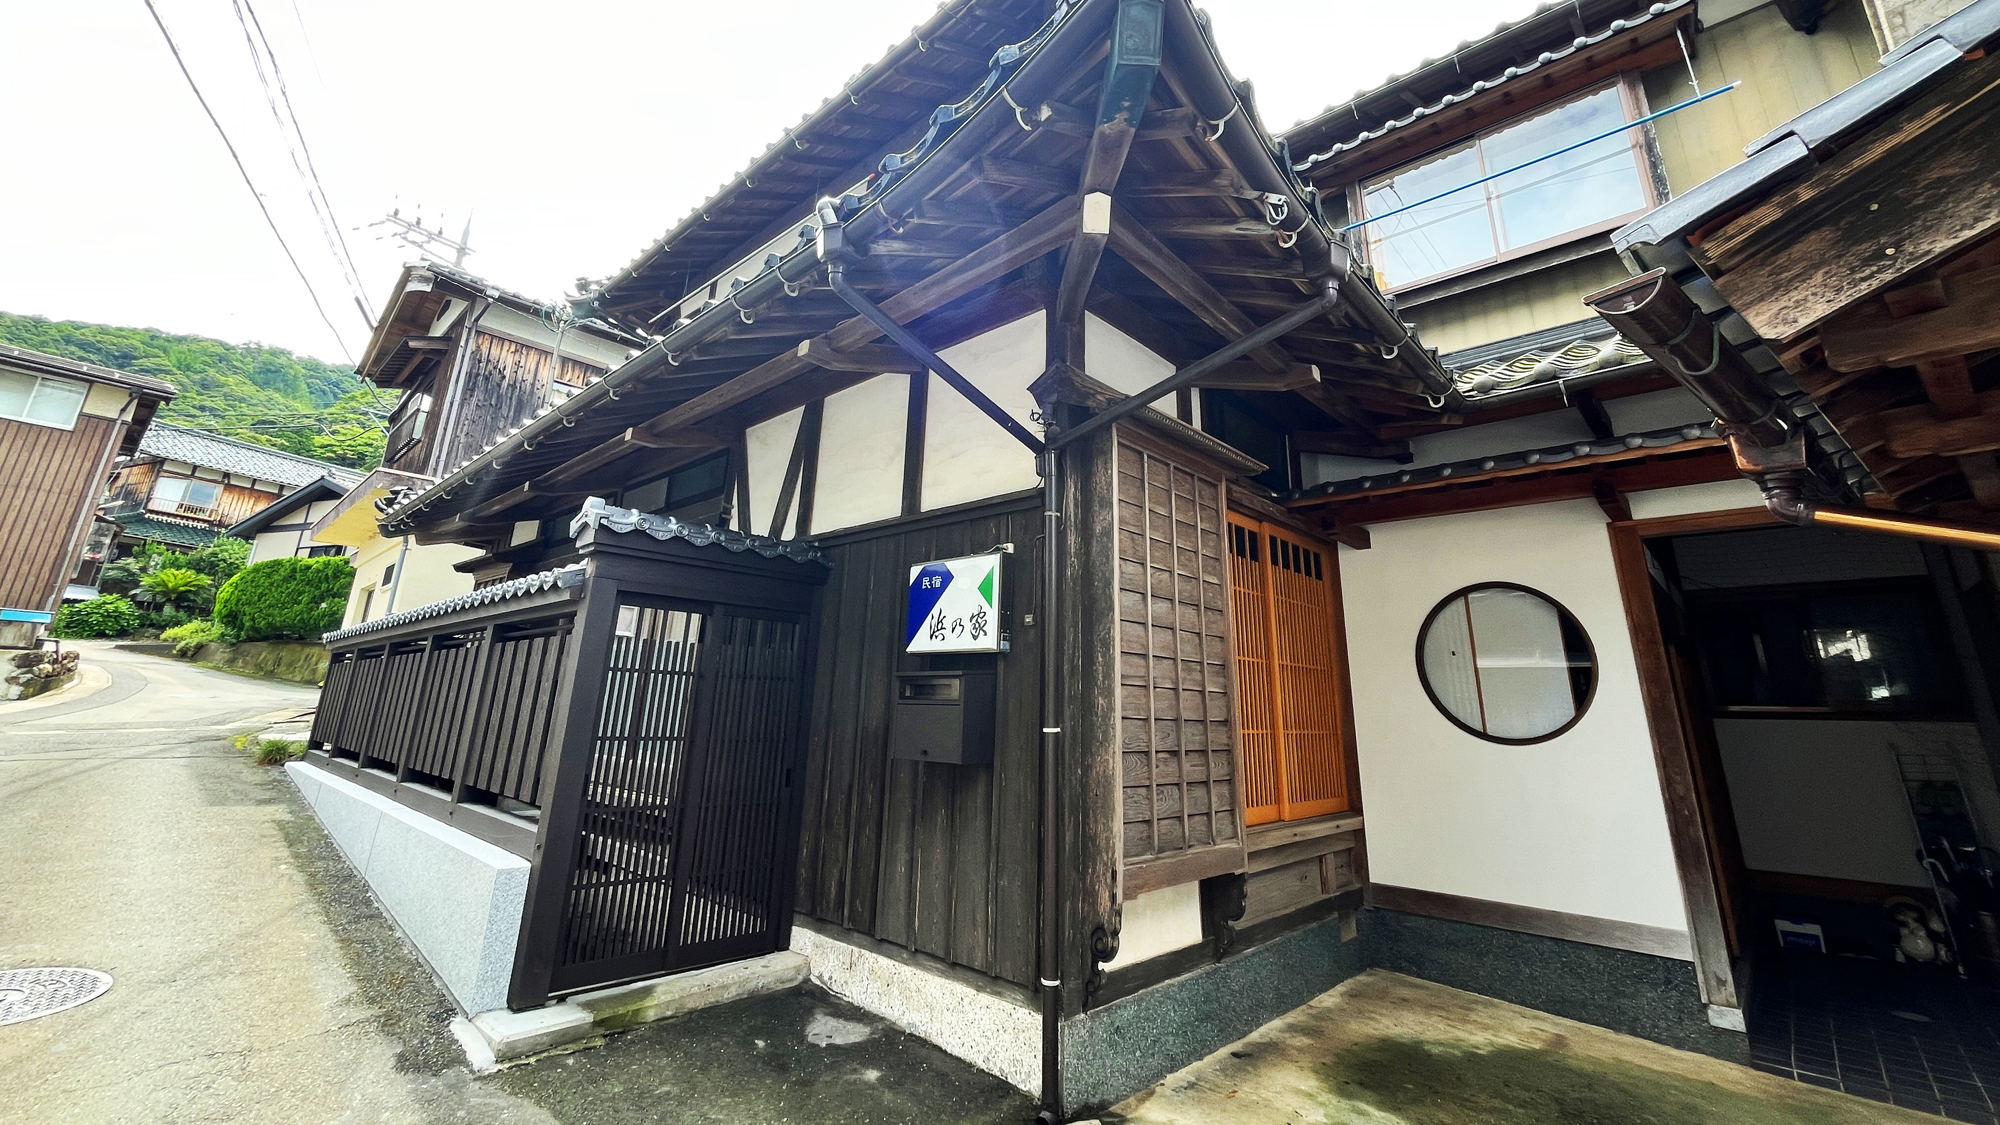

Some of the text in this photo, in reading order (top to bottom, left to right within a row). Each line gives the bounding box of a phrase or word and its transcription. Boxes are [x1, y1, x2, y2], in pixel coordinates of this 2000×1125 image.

[922, 575, 942, 589] 民宿
[930, 604, 988, 641] 浜乃家
